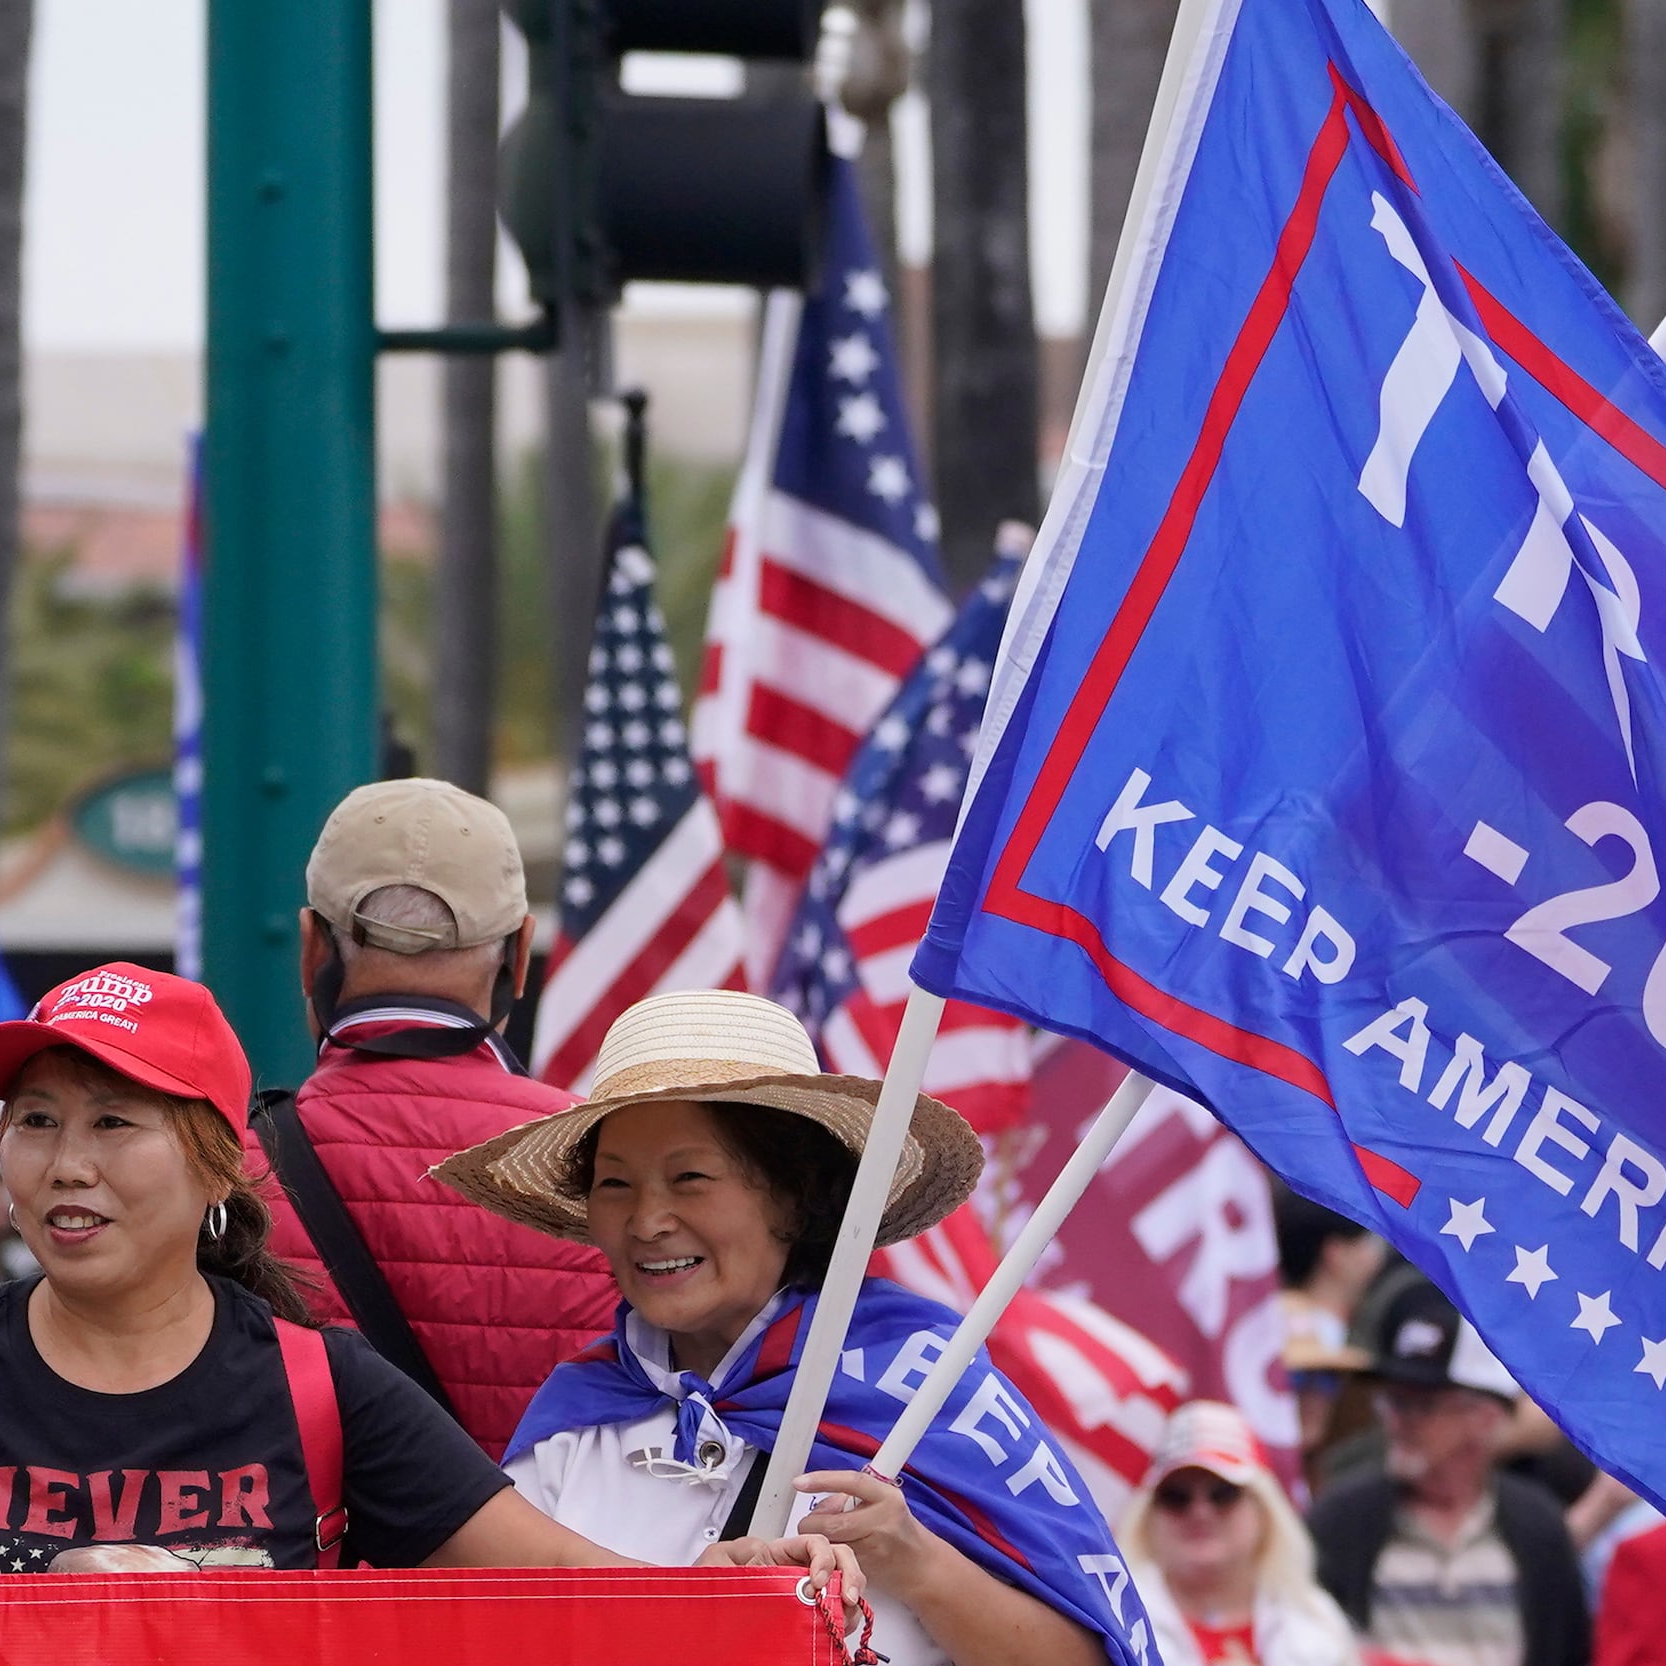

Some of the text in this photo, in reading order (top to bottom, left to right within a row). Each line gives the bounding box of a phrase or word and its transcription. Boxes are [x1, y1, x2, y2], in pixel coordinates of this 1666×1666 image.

[1095, 767, 1356, 984] KEEP
[76, 994, 127, 1012] 2020
[99, 1013, 139, 1034] GREAT!
[840, 1330, 1079, 1507] EEP
